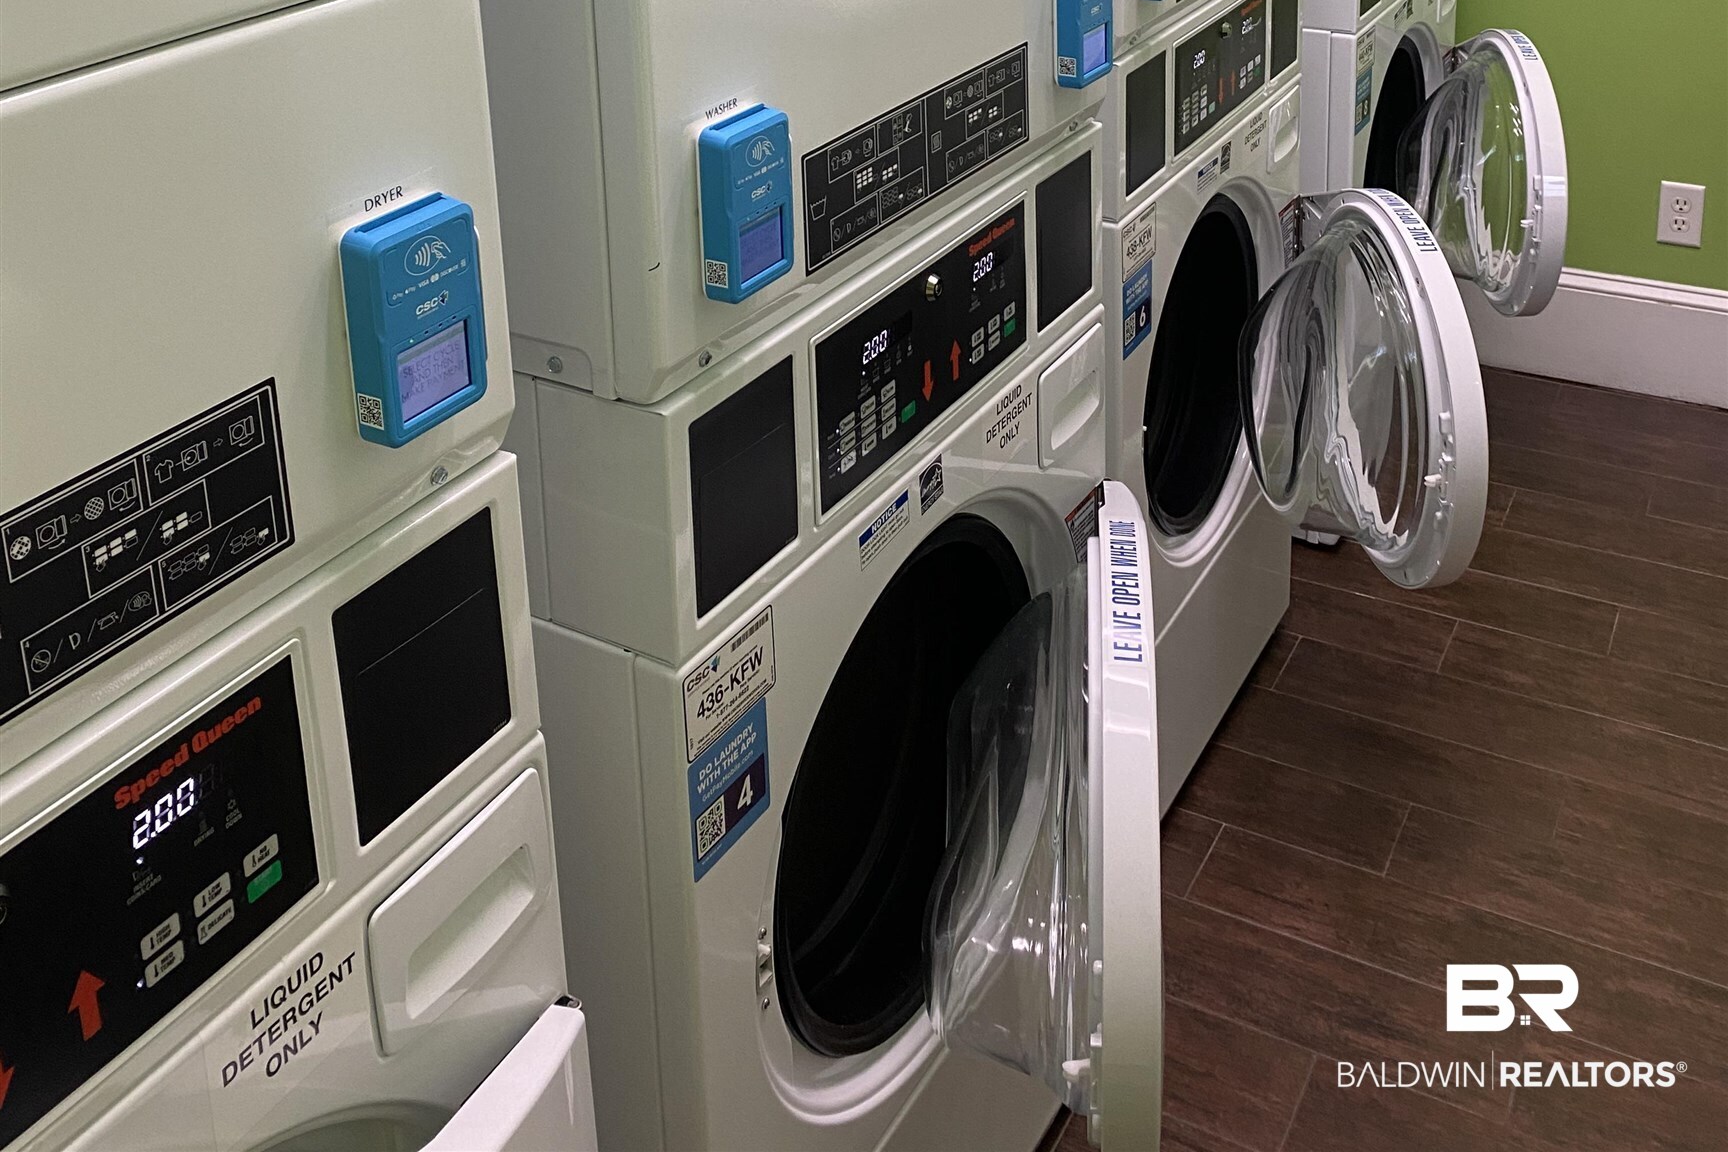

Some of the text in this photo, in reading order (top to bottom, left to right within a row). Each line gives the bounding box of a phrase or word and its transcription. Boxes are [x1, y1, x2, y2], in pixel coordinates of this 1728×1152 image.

[705, 97, 738, 121] WASHER
[364, 185, 404, 213] DRYER
[751, 185, 766, 200] CSC
[1407, 227, 1438, 252] LEAVE
[416, 297, 438, 315] CSC
[1140, 305, 1146, 327] 6
[403, 355, 431, 378] SELECT
[997, 384, 1022, 416] LIQUID
[986, 392, 1032, 444] DETERGENT
[1000, 421, 1020, 449] ONLY
[871, 503, 897, 534] NOTICE
[1110, 539, 1138, 566] WHEN
[1111, 571, 1141, 605] OPEN
[1113, 611, 1143, 662] LEAVE
[687, 665, 710, 693] CSC
[697, 646, 763, 718] 436-KFW
[114, 697, 262, 809] Speed Queen
[697, 732, 757, 794] WITH THE APP
[699, 764, 712, 781] DO
[714, 722, 754, 765] LAUNDRY
[702, 750, 754, 802] GetPayMobile.com
[737, 774, 754, 810] 4
[133, 777, 195, 849] 2.00
[207, 907, 232, 930] DELICATE
[250, 952, 323, 1030] LIQUID
[221, 951, 355, 1088] DETERGENT
[266, 1011, 323, 1077] ONLY
